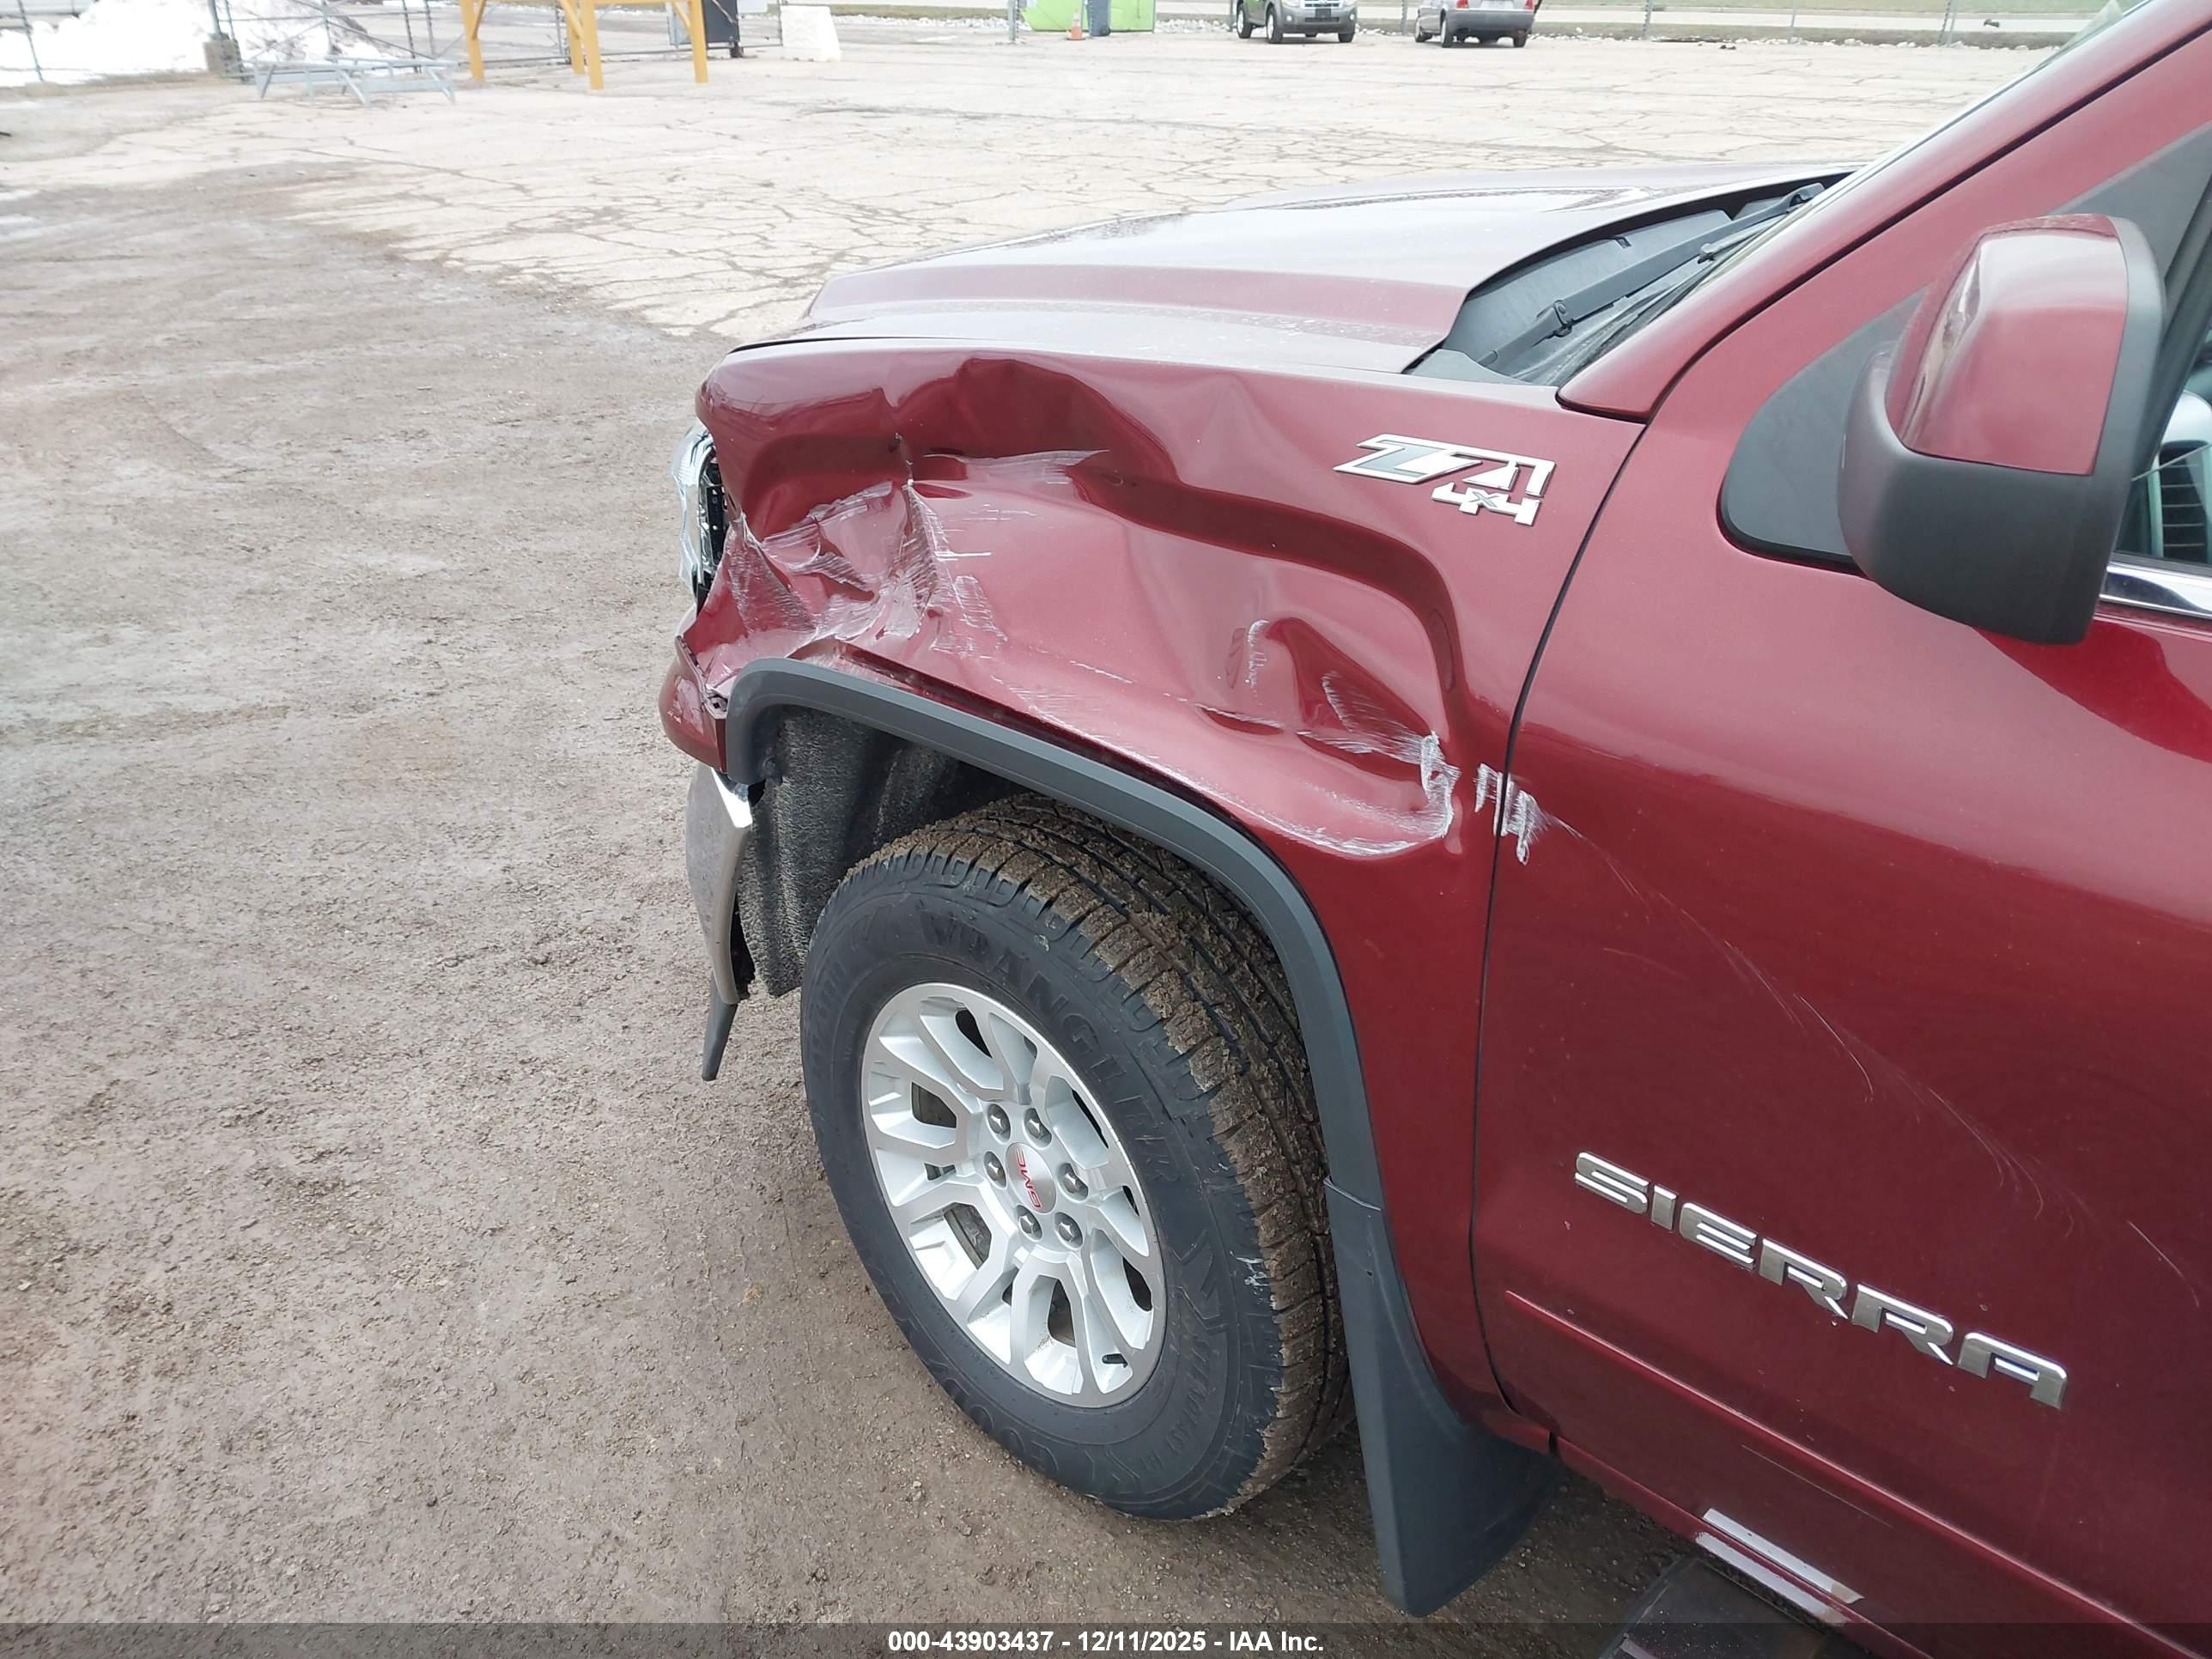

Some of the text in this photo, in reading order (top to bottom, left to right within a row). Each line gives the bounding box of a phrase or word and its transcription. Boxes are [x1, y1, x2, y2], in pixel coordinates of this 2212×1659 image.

[1332, 432, 1556, 498] Z71
[1016, 1147, 1042, 1209] GMC
[1574, 1151, 2068, 1410] SIERRA
